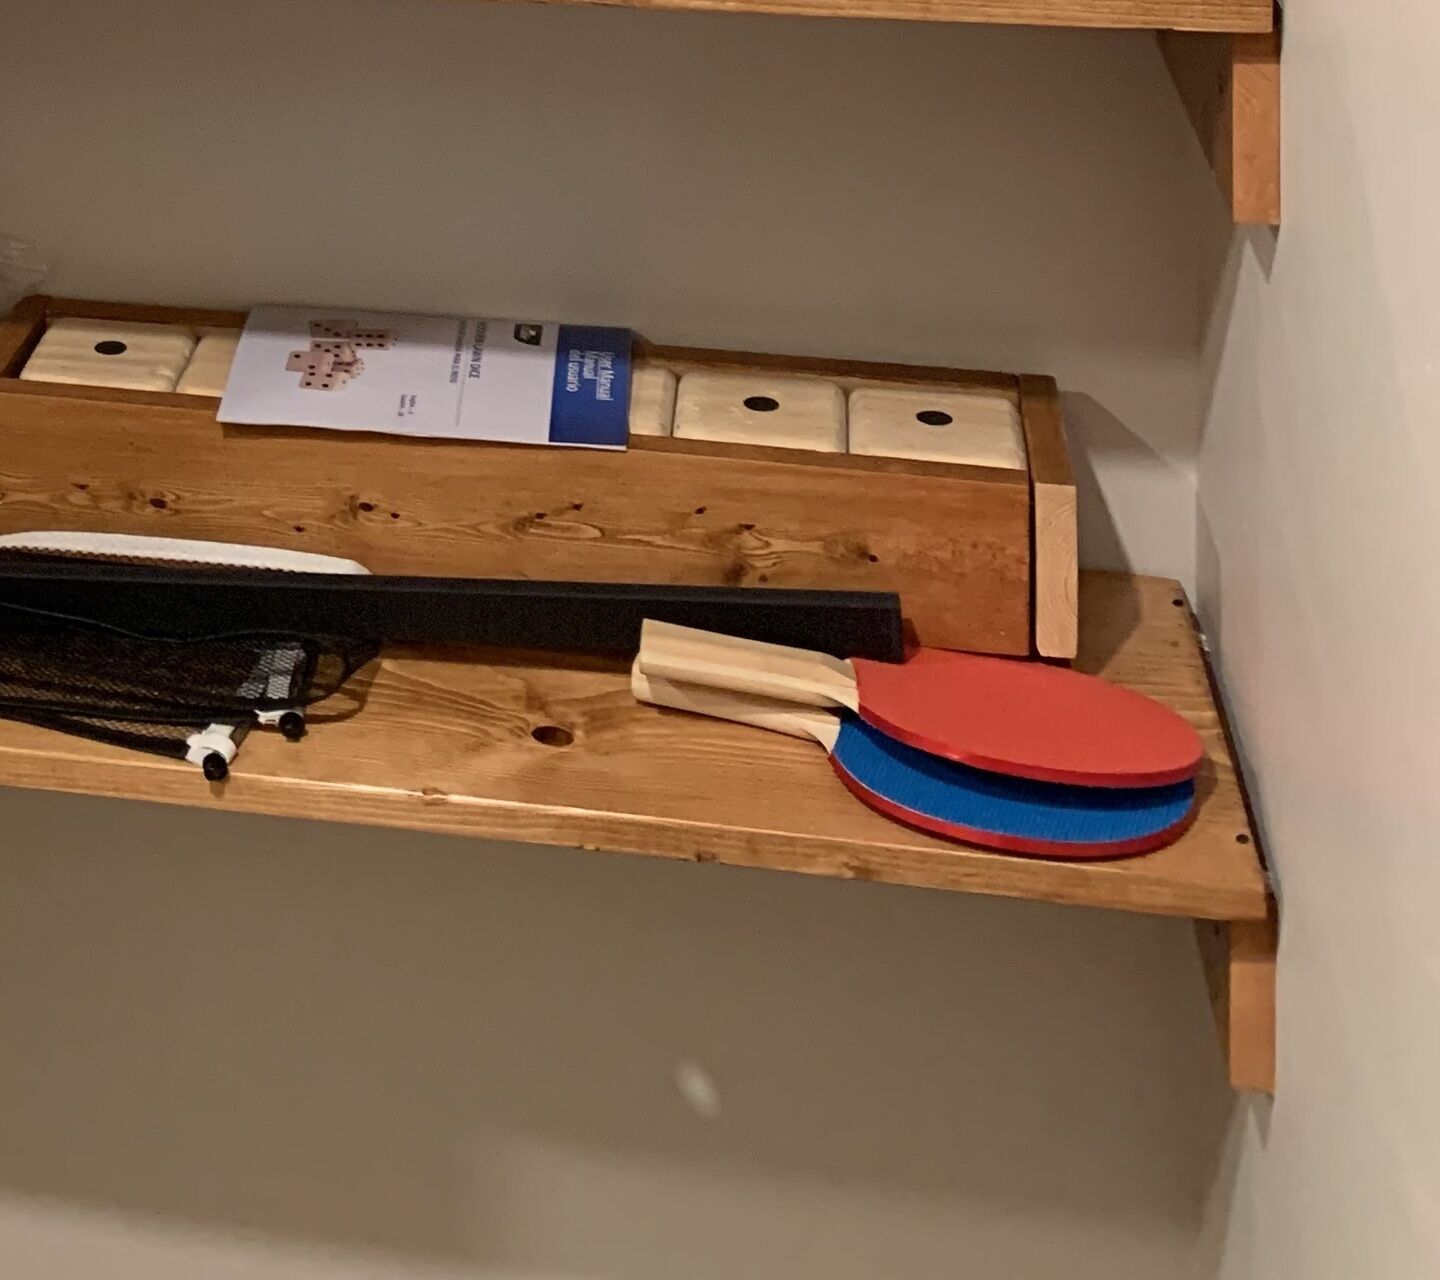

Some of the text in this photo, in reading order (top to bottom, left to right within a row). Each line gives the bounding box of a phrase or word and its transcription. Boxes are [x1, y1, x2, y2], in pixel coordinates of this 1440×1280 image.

[470, 343, 482, 363] LAWN
[582, 350, 598, 380] Manual
[468, 363, 481, 379] DICE
[565, 349, 580, 392] del usuario
[596, 351, 616, 400] User Manual
